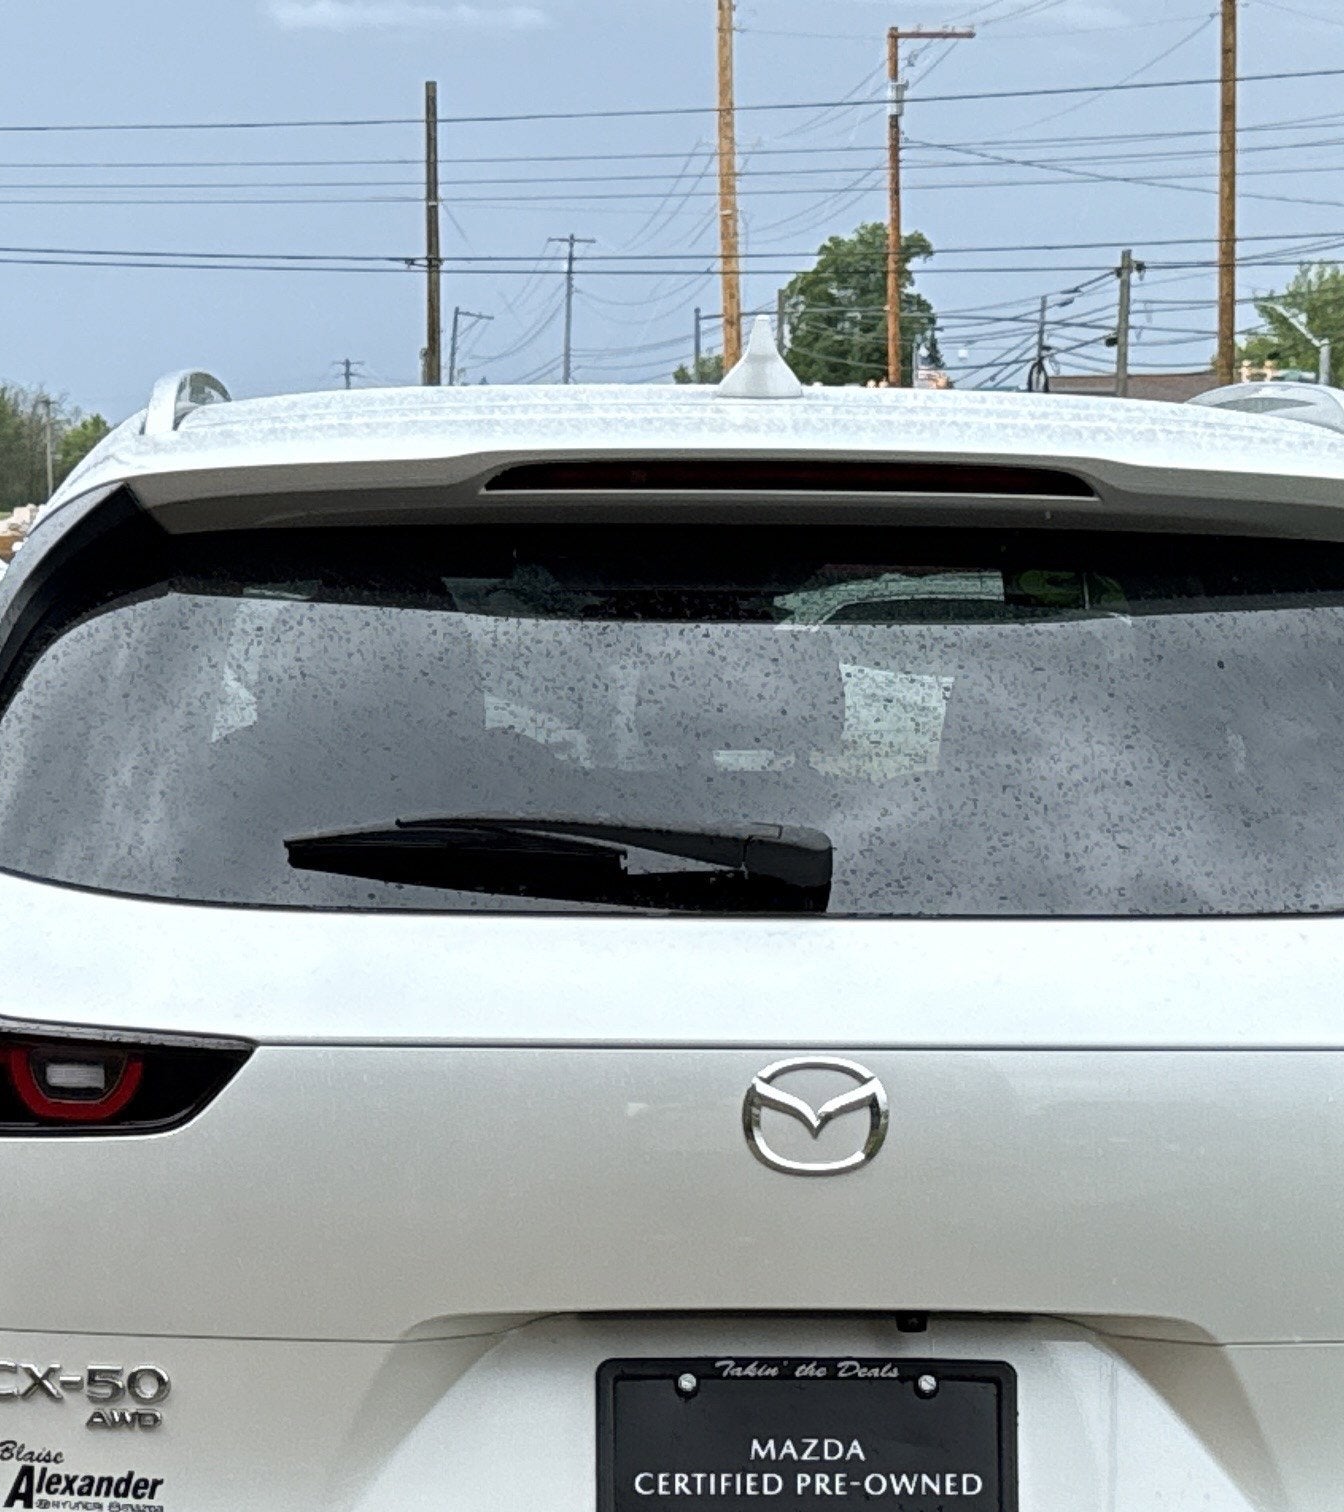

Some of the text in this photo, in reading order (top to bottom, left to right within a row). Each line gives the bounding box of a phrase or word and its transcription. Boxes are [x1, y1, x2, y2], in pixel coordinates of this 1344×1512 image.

[715, 1360, 900, 1379] Takin' the Deals
[86, 1408, 162, 1431] AWD
[749, 1438, 867, 1462] MAZDA
[3, 1464, 165, 1509] Alexander
[634, 1472, 984, 1496] CERTIFIED PRE-OWNED
